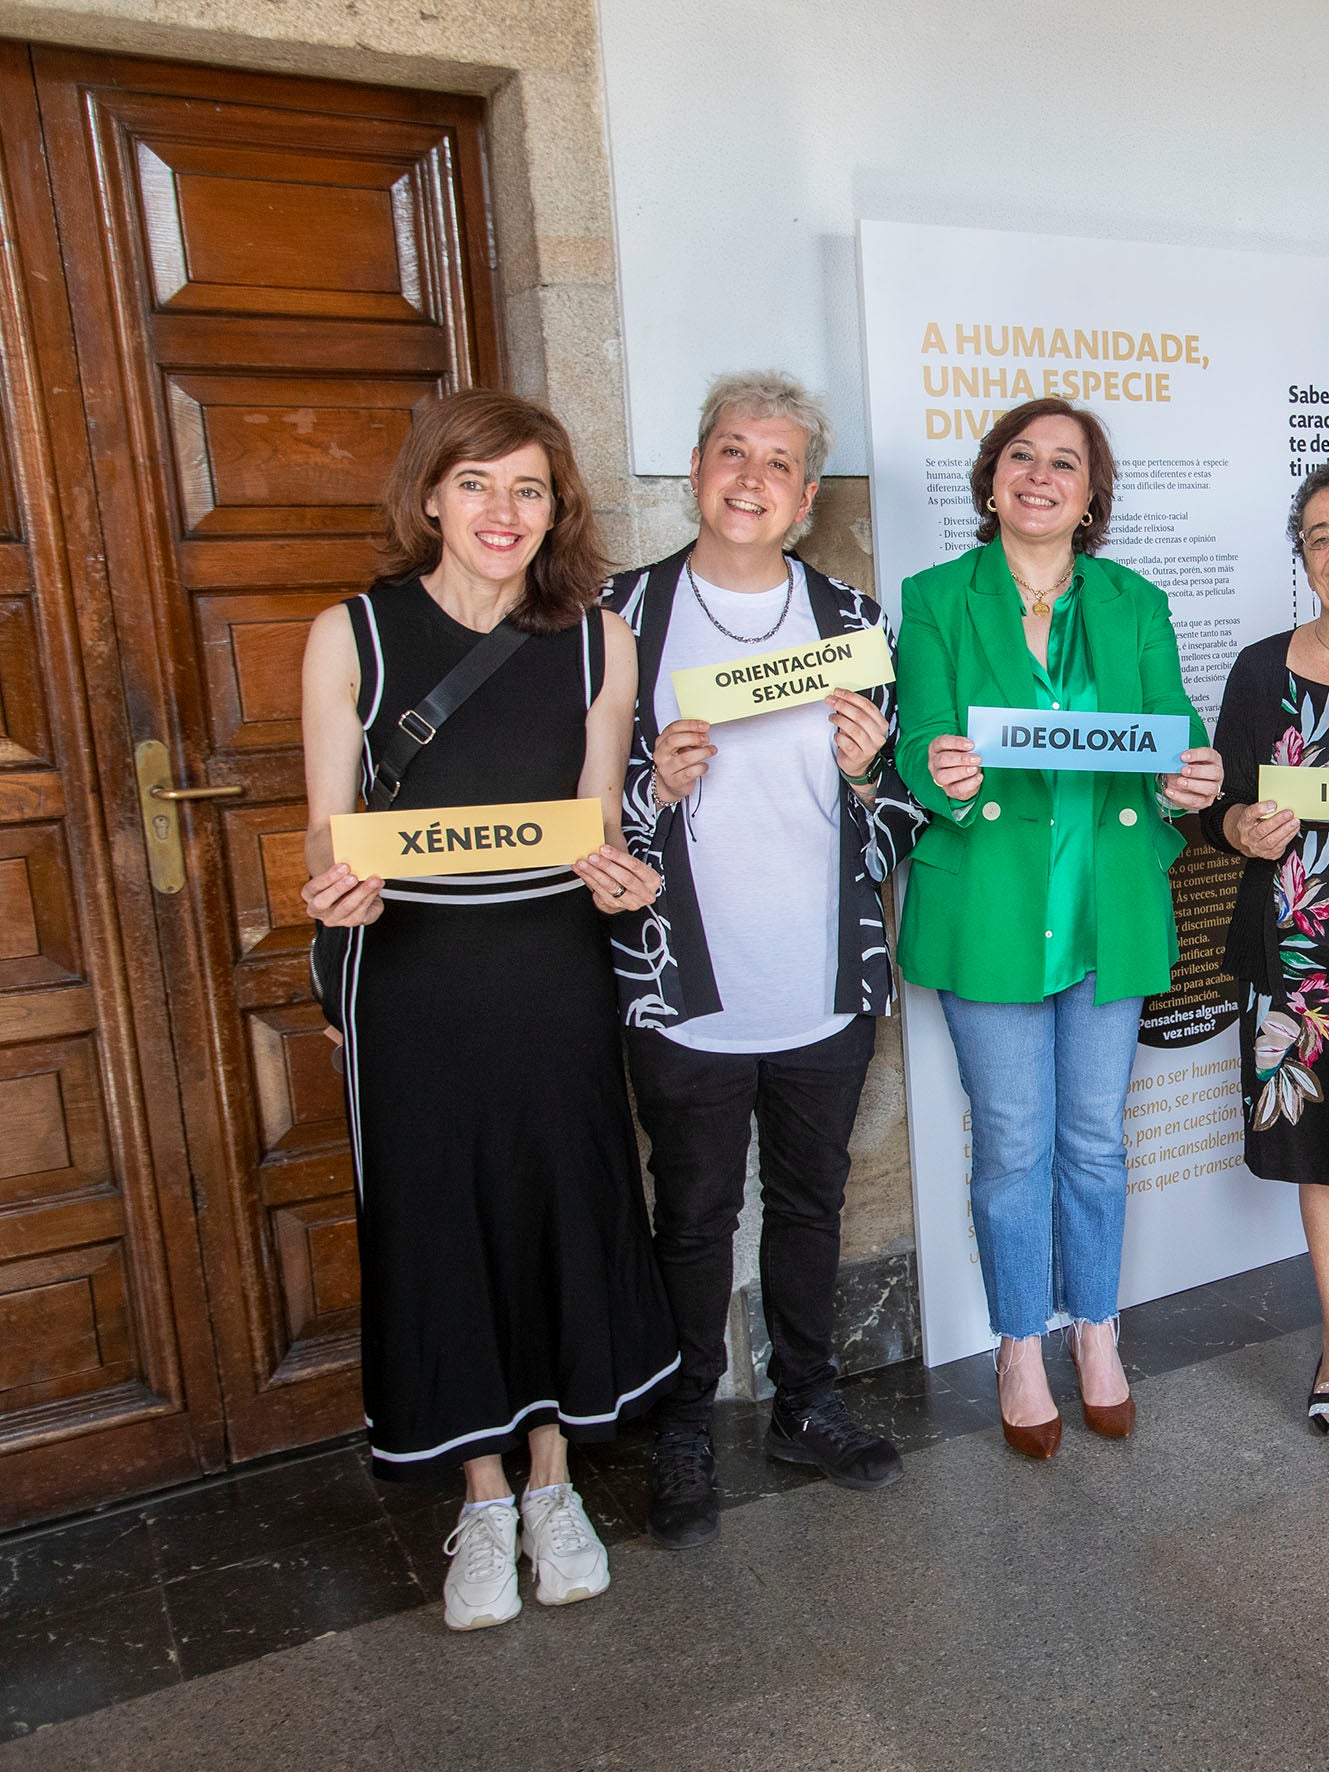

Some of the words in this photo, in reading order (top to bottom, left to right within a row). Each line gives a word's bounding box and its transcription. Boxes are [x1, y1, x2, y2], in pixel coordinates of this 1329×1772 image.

[921, 322, 948, 354] A
[955, 323, 1210, 370] HUMANIDADE,
[923, 365, 1034, 400] UNHA
[1043, 369, 1172, 402] ESPECIE
[1289, 437, 1306, 452] te
[925, 458, 935, 467] Se
[938, 458, 963, 467] existe
[1132, 460, 1146, 468] que
[1147, 459, 1194, 468] pertencemos
[1203, 459, 1229, 468] especie
[1290, 458, 1302, 477] ti
[926, 471, 964, 480] humana,
[1125, 471, 1149, 479] somos
[1150, 470, 1186, 478] diferentes
[927, 483, 970, 493] diferenzas
[1122, 482, 1136, 490] son
[1166, 481, 1177, 490] de
[1177, 481, 1211, 490] imaxinar.
[928, 497, 939, 505] As
[1143, 511, 1189, 521] étnico-racial
[1143, 524, 1175, 533] relixiosa
[1143, 536, 1153, 545] de
[1154, 536, 1182, 545] crenzas
[1188, 535, 1216, 545] opinión
[1164, 557, 1177, 565] por
[1177, 555, 1208, 564] exemplo
[1215, 553, 1239, 562] timbre
[1152, 567, 1178, 576] Outras,
[1218, 565, 1234, 573] máis
[1172, 578, 1188, 587] desa
[1189, 578, 1213, 588] persoa
[1214, 578, 1230, 586] para
[1168, 589, 1195, 598] escoita,
[1205, 588, 1235, 597] películas
[1189, 620, 1202, 628] que
[1214, 617, 1240, 626] persoas
[1200, 630, 1218, 638] tanto
[1188, 640, 1227, 650] inseparable
[715, 643, 853, 688] ORIENTACIÓN
[1184, 675, 1191, 684] de
[1193, 674, 1227, 683] decisións.
[752, 674, 829, 704] SEXUAL
[1001, 724, 1157, 753] IDEOLOXÍA
[398, 821, 543, 856] XÉNERO
[1186, 848, 1191, 857] é
[1193, 844, 1216, 857] máis
[1179, 865, 1185, 873] o
[1187, 862, 1205, 874] que
[1207, 857, 1229, 870] máis
[1231, 856, 1241, 865] se
[1183, 871, 1237, 888] converterse
[1190, 889, 1218, 901] veces,
[1219, 886, 1238, 897] non
[1193, 901, 1224, 915] norma
[1171, 961, 1219, 980] privilexios
[1183, 979, 1204, 992] para
[1149, 990, 1221, 1012] discriminación.
[1138, 1010, 1194, 1030] Pensaches
[1195, 1000, 1239, 1020] algunha
[1163, 1028, 1183, 1041] vez
[1184, 1019, 1217, 1036] nisto?
[1156, 1074, 1165, 1087] o
[1168, 1068, 1189, 1085] ser
[1175, 1093, 1189, 1109] se
[1136, 1125, 1162, 1148] pon
[1164, 1121, 1180, 1135] en
[1183, 1104, 1237, 1131] cuestión
[1126, 1151, 1157, 1170] usca
[1159, 1130, 1245, 1162] incansableme
[1155, 1170, 1180, 1191] que
[1182, 1168, 1191, 1180] o
[1193, 1153, 1245, 1177] transce
